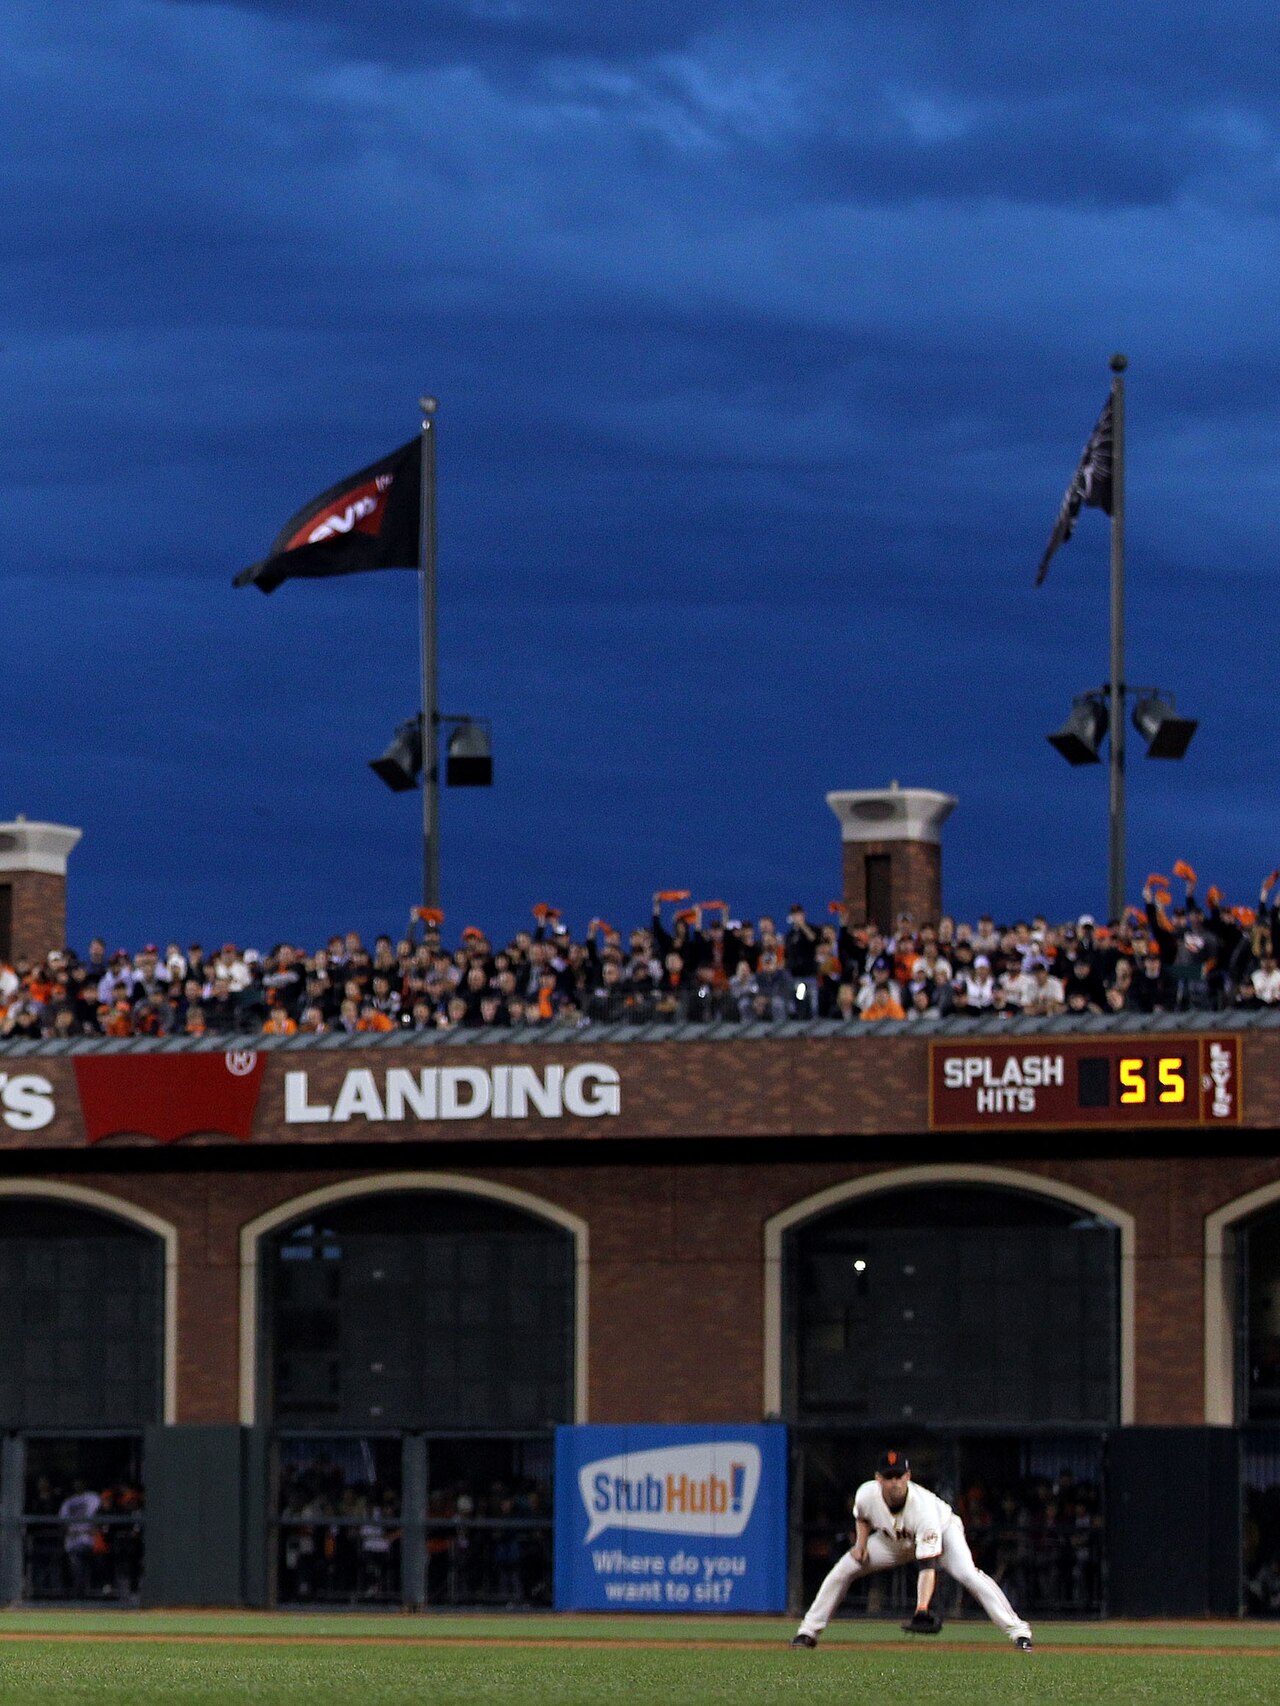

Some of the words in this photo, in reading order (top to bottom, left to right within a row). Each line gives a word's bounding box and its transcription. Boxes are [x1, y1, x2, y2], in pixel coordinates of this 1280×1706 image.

[943, 1055, 1064, 1088] SPLASH
[1120, 1057, 1185, 1104] 55
[284, 1063, 622, 1125] LANDING
[976, 1087, 1037, 1113] HITS
[592, 1460, 746, 1513] StubHub!
[592, 1549, 664, 1575] Where
[668, 1549, 699, 1575] do
[703, 1553, 747, 1581] you
[605, 1580, 662, 1602] want
[666, 1580, 690, 1602] to
[694, 1578, 734, 1603] sit?
